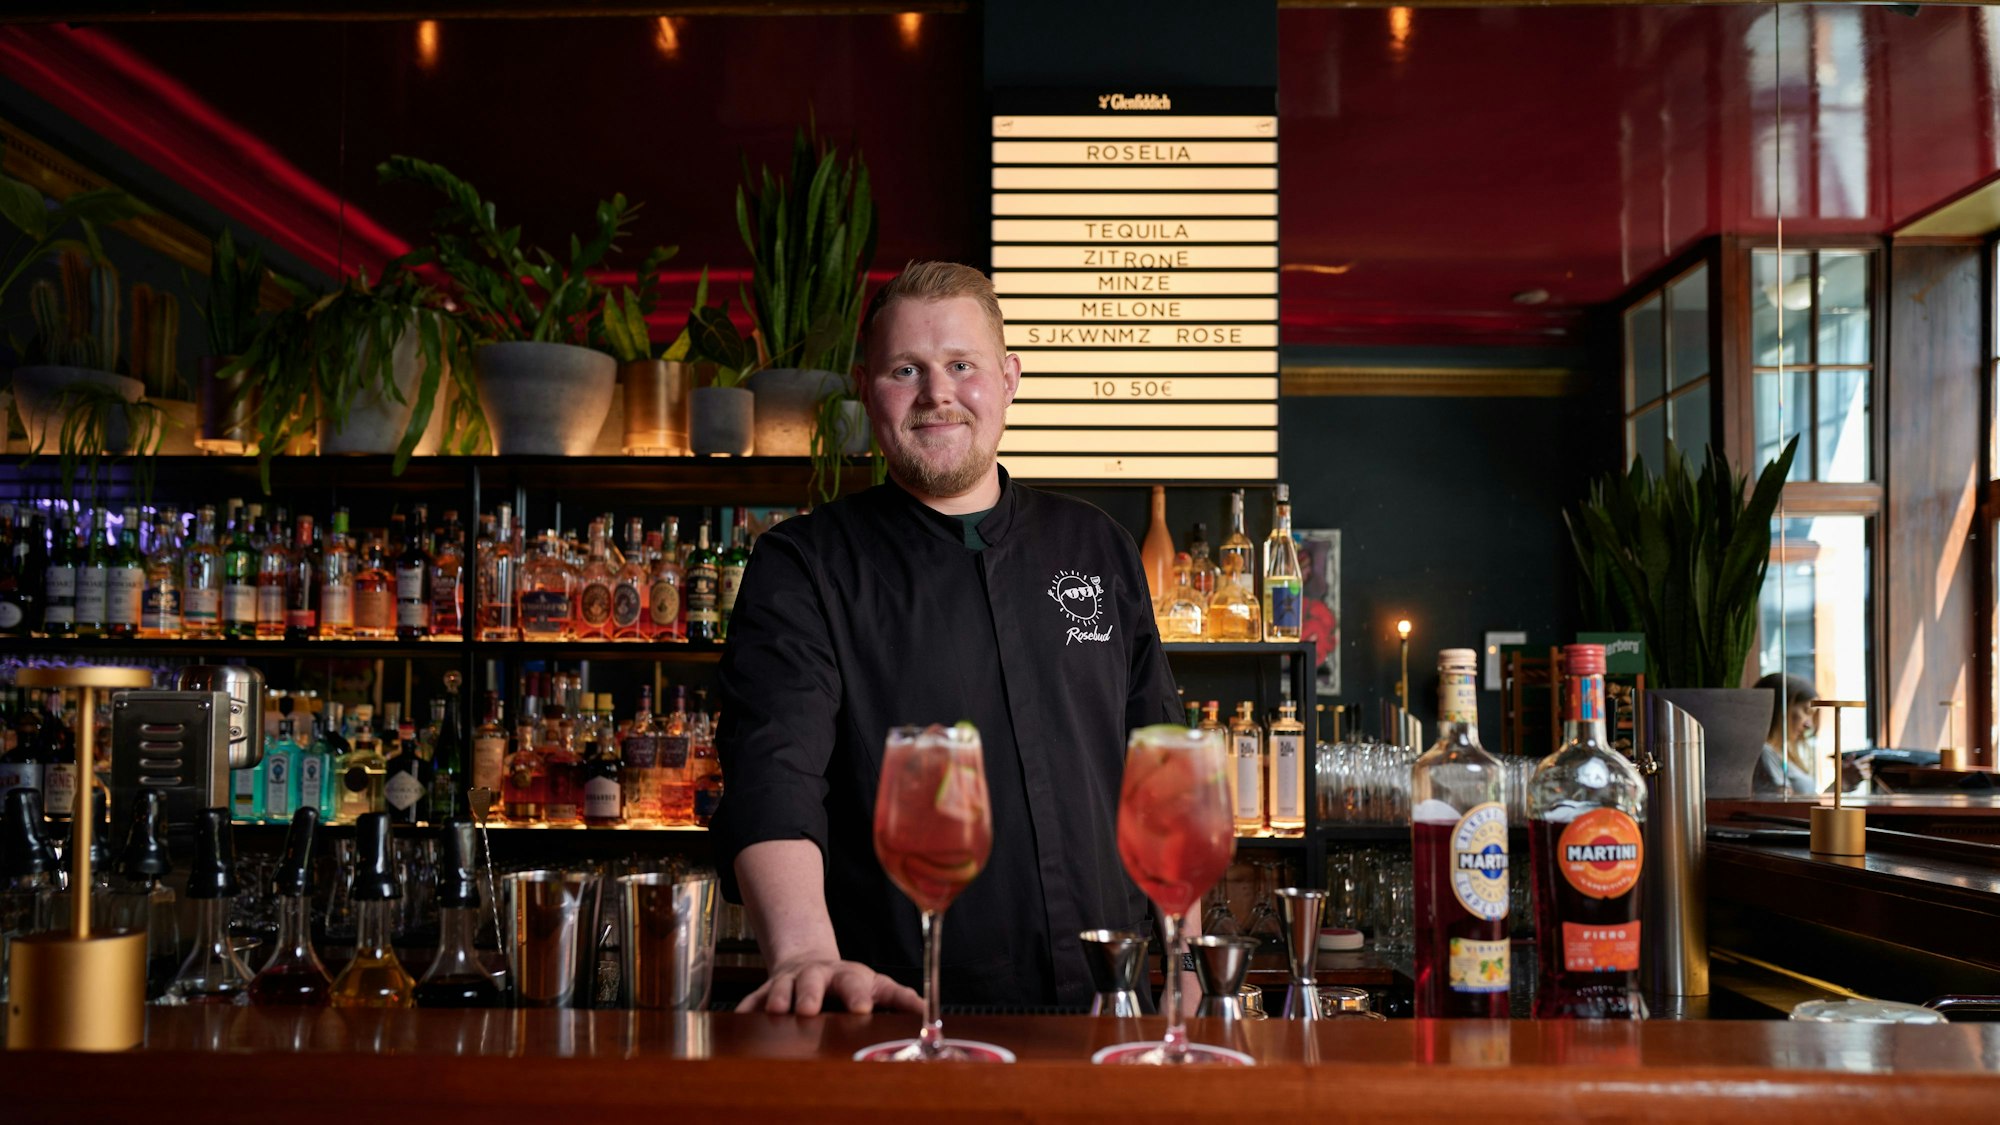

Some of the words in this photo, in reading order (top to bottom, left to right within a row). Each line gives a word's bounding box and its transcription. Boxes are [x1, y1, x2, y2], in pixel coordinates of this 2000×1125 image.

[1110, 93, 1171, 110] Glenfiddich
[1087, 145, 1191, 161] ROSELIA
[1084, 223, 1189, 239] TEQUILA
[1083, 250, 1189, 269] ZITRONE
[1098, 275, 1171, 291] MINZE
[1081, 302, 1182, 317] MELONE
[1028, 328, 1152, 344] SJKWNMZ
[1176, 328, 1243, 344] ROSE
[1092, 381, 1116, 397] 10
[1130, 381, 1173, 397] 50€
[1066, 625, 1113, 646] Rosebud
[1605, 638, 1641, 656] erberg
[1567, 844, 1637, 861] MARTINI
[1583, 930, 1627, 941] FIERO
